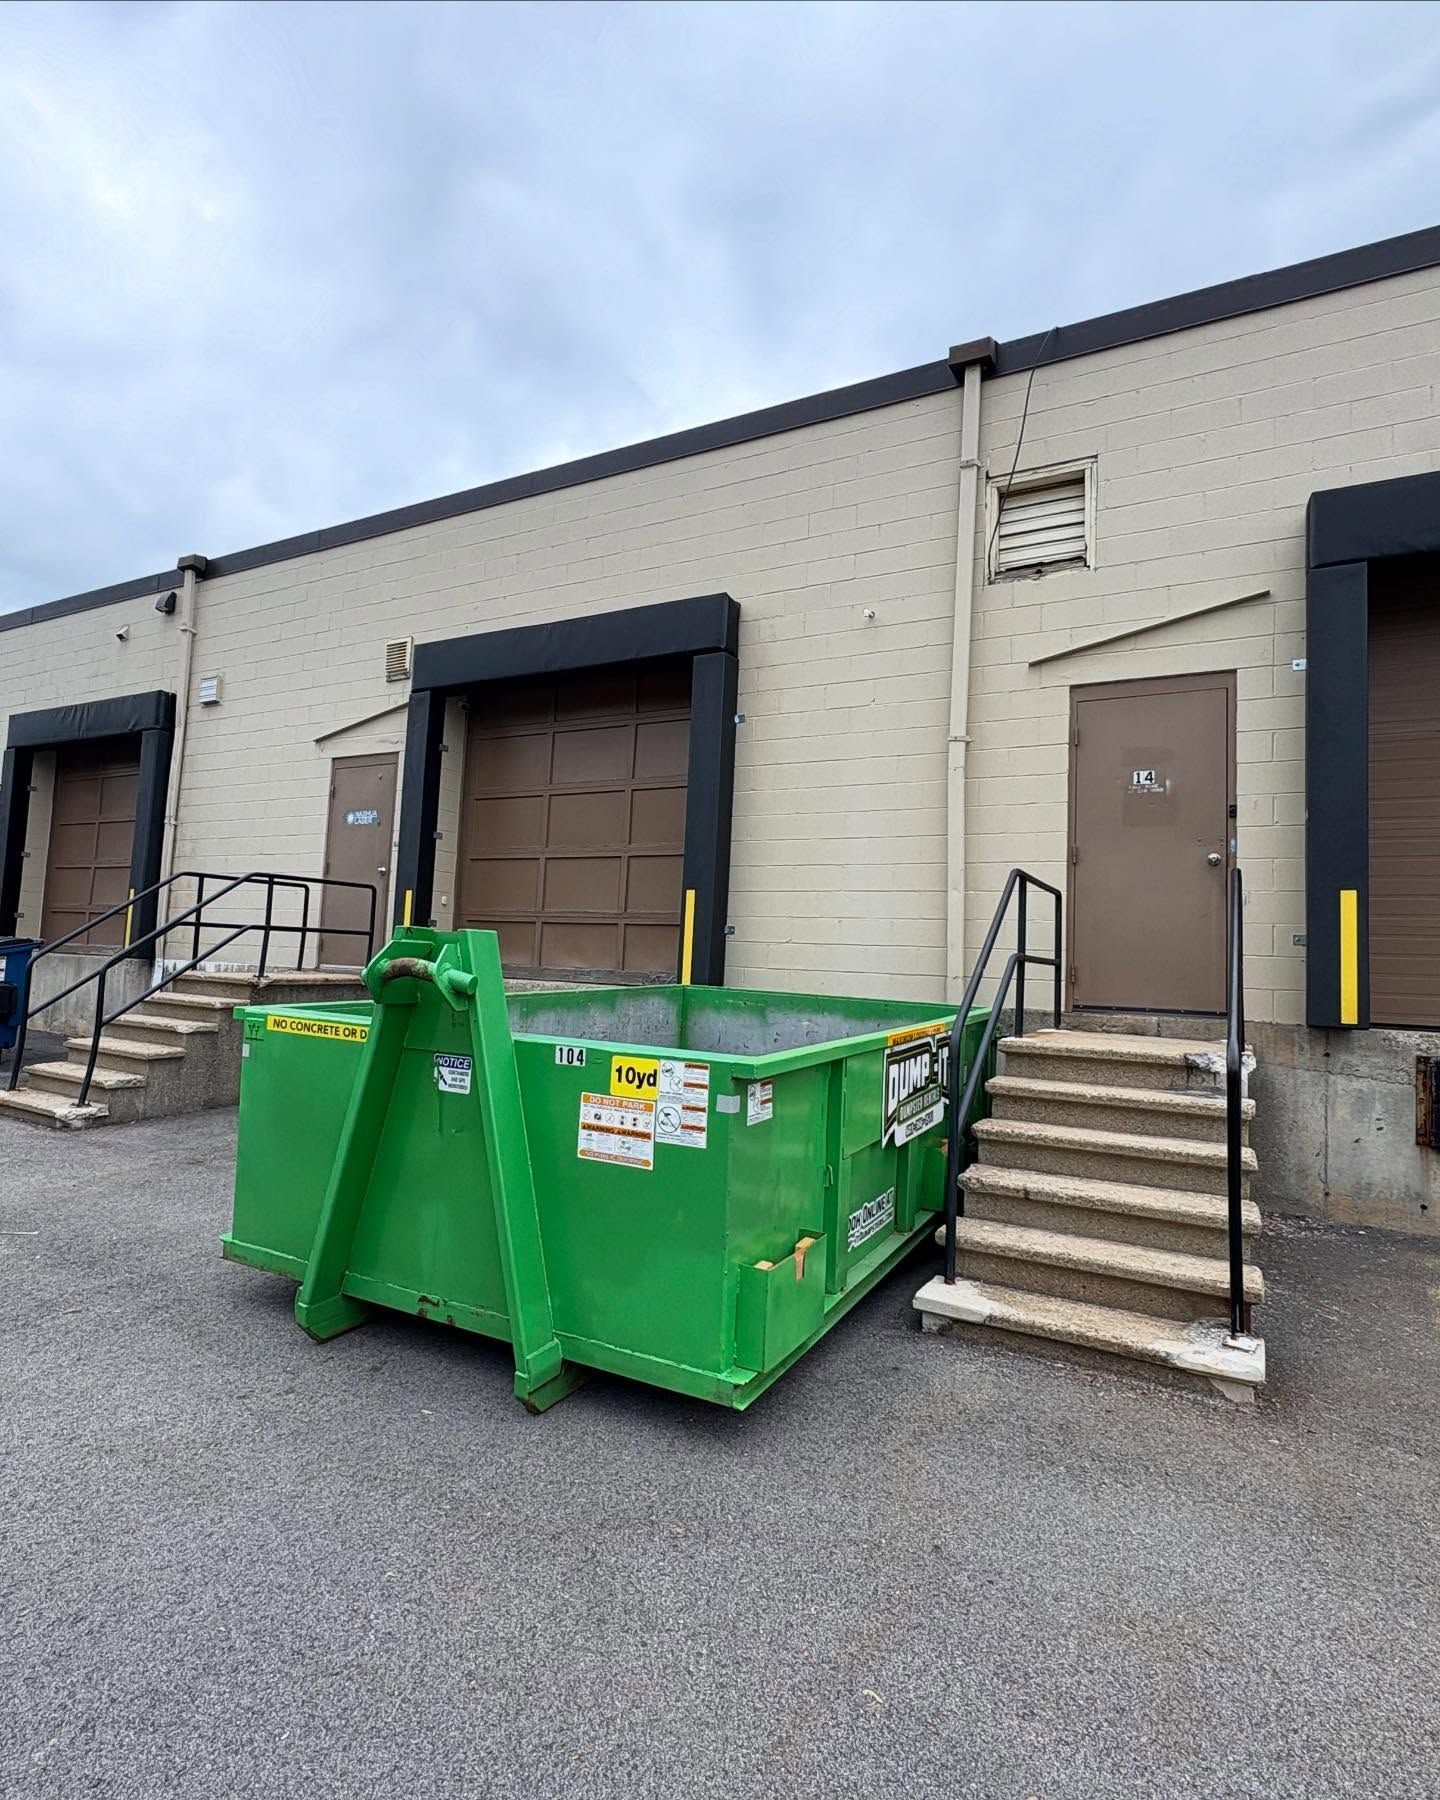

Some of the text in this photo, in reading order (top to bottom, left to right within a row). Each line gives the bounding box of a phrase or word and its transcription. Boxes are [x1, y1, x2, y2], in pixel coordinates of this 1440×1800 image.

[1135, 771, 1153, 784] 14
[273, 1019, 368, 1040] NO CONCRETE OR D
[437, 1056, 470, 1069] NOTICE
[558, 1047, 584, 1066] 104
[616, 1065, 657, 1090] 10yd
[589, 1096, 646, 1110] DO NOT PARK
